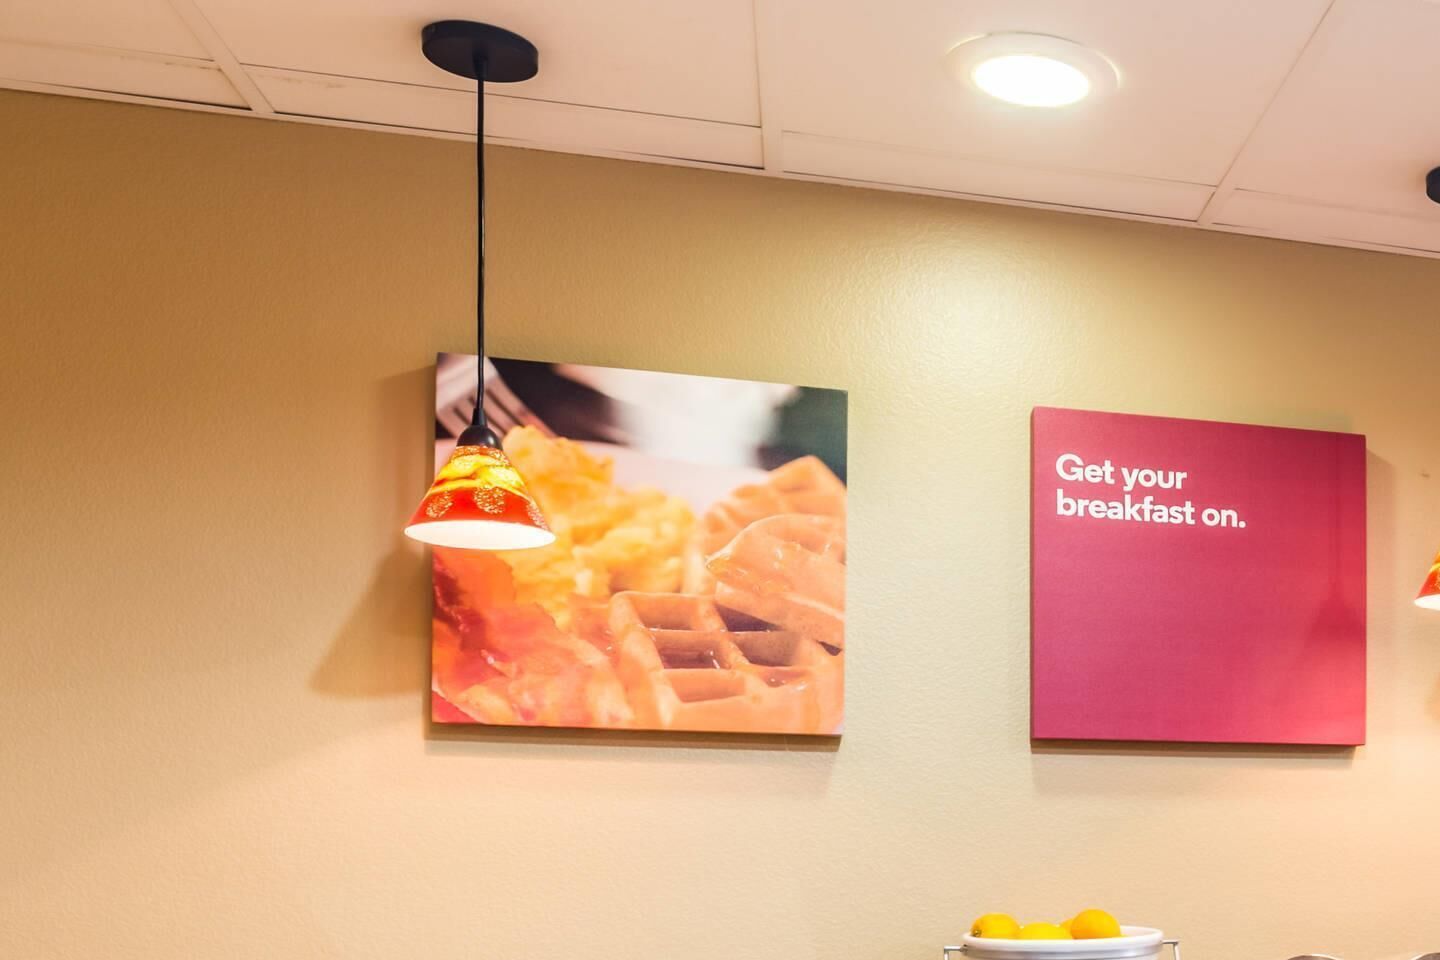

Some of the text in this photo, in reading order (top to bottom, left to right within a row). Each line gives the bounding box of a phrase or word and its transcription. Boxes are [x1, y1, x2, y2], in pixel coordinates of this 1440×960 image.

[1055, 453, 1188, 491] Get your
[1056, 488, 1247, 528] breakfast on.
